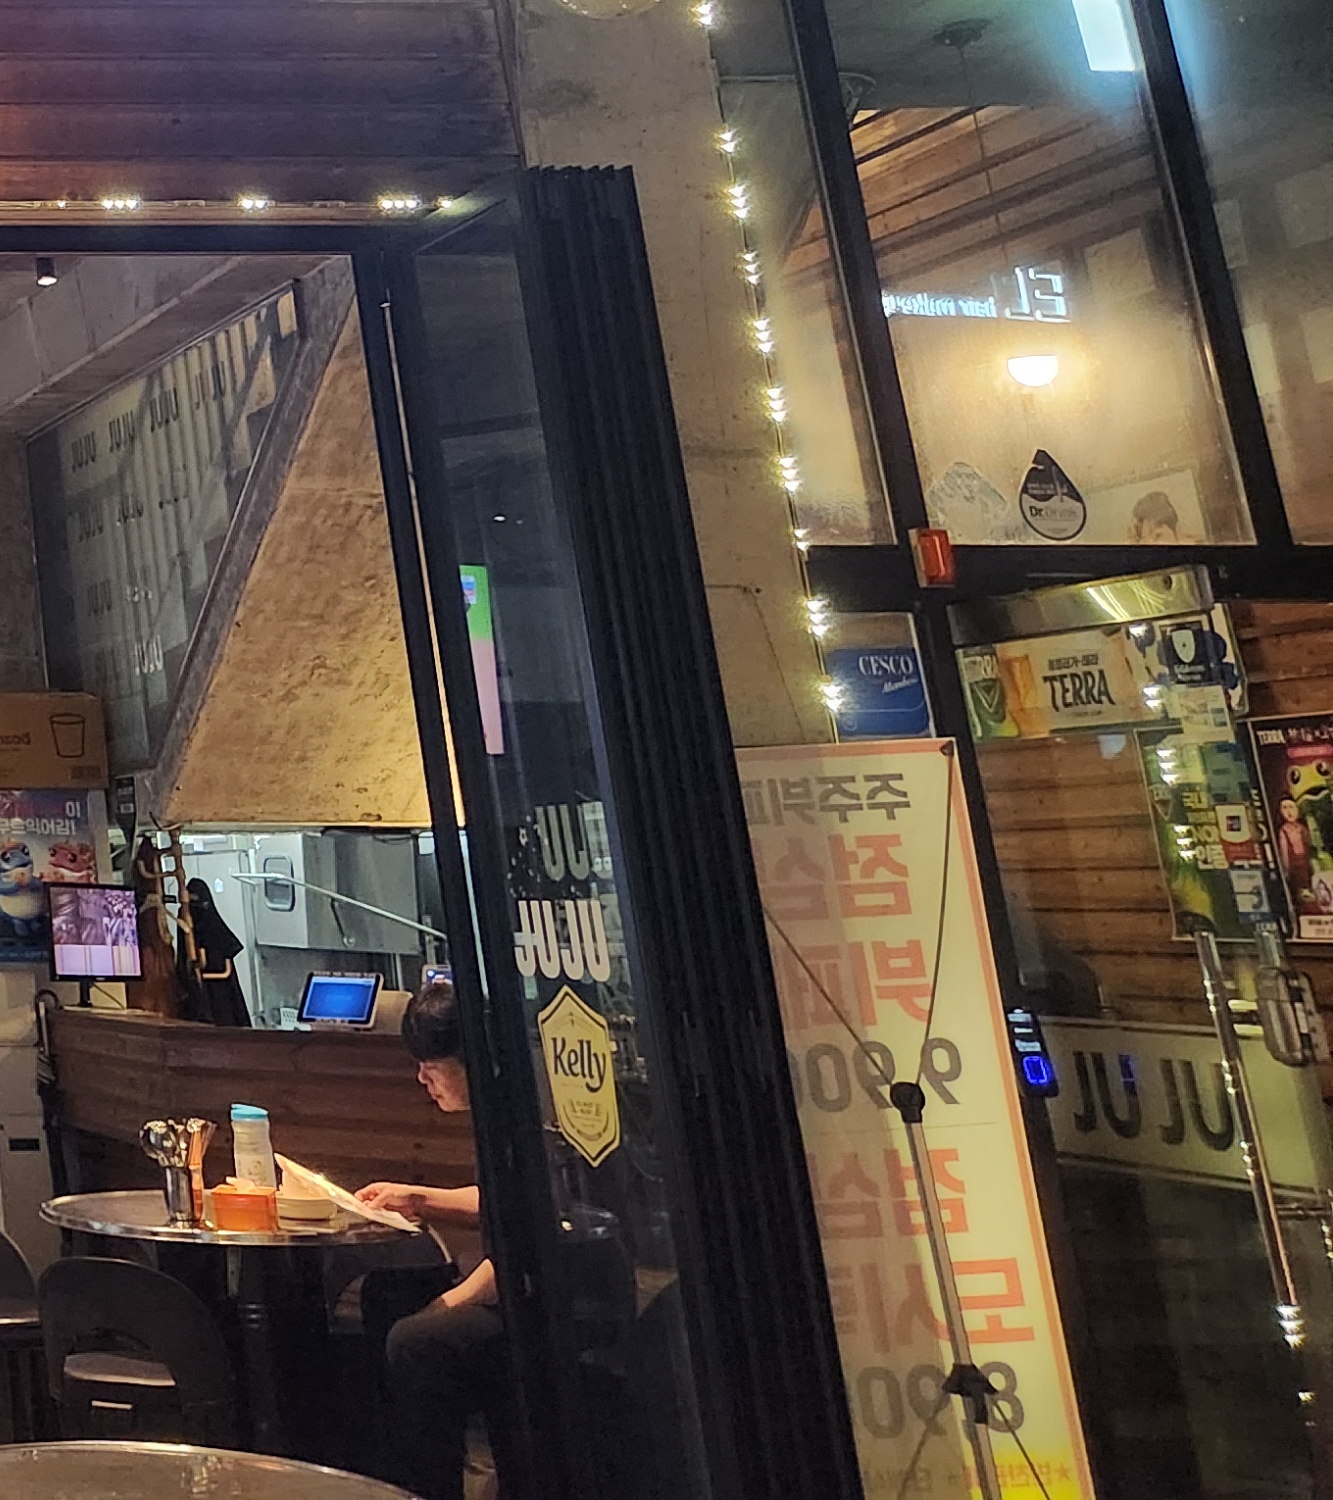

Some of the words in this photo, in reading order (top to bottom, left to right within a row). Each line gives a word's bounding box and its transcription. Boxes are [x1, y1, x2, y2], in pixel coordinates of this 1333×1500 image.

[858, 652, 914, 678] CESCO
[1042, 668, 1115, 714] TERRA
[514, 900, 611, 983] JUJU
[551, 1036, 607, 1093] Kelly
